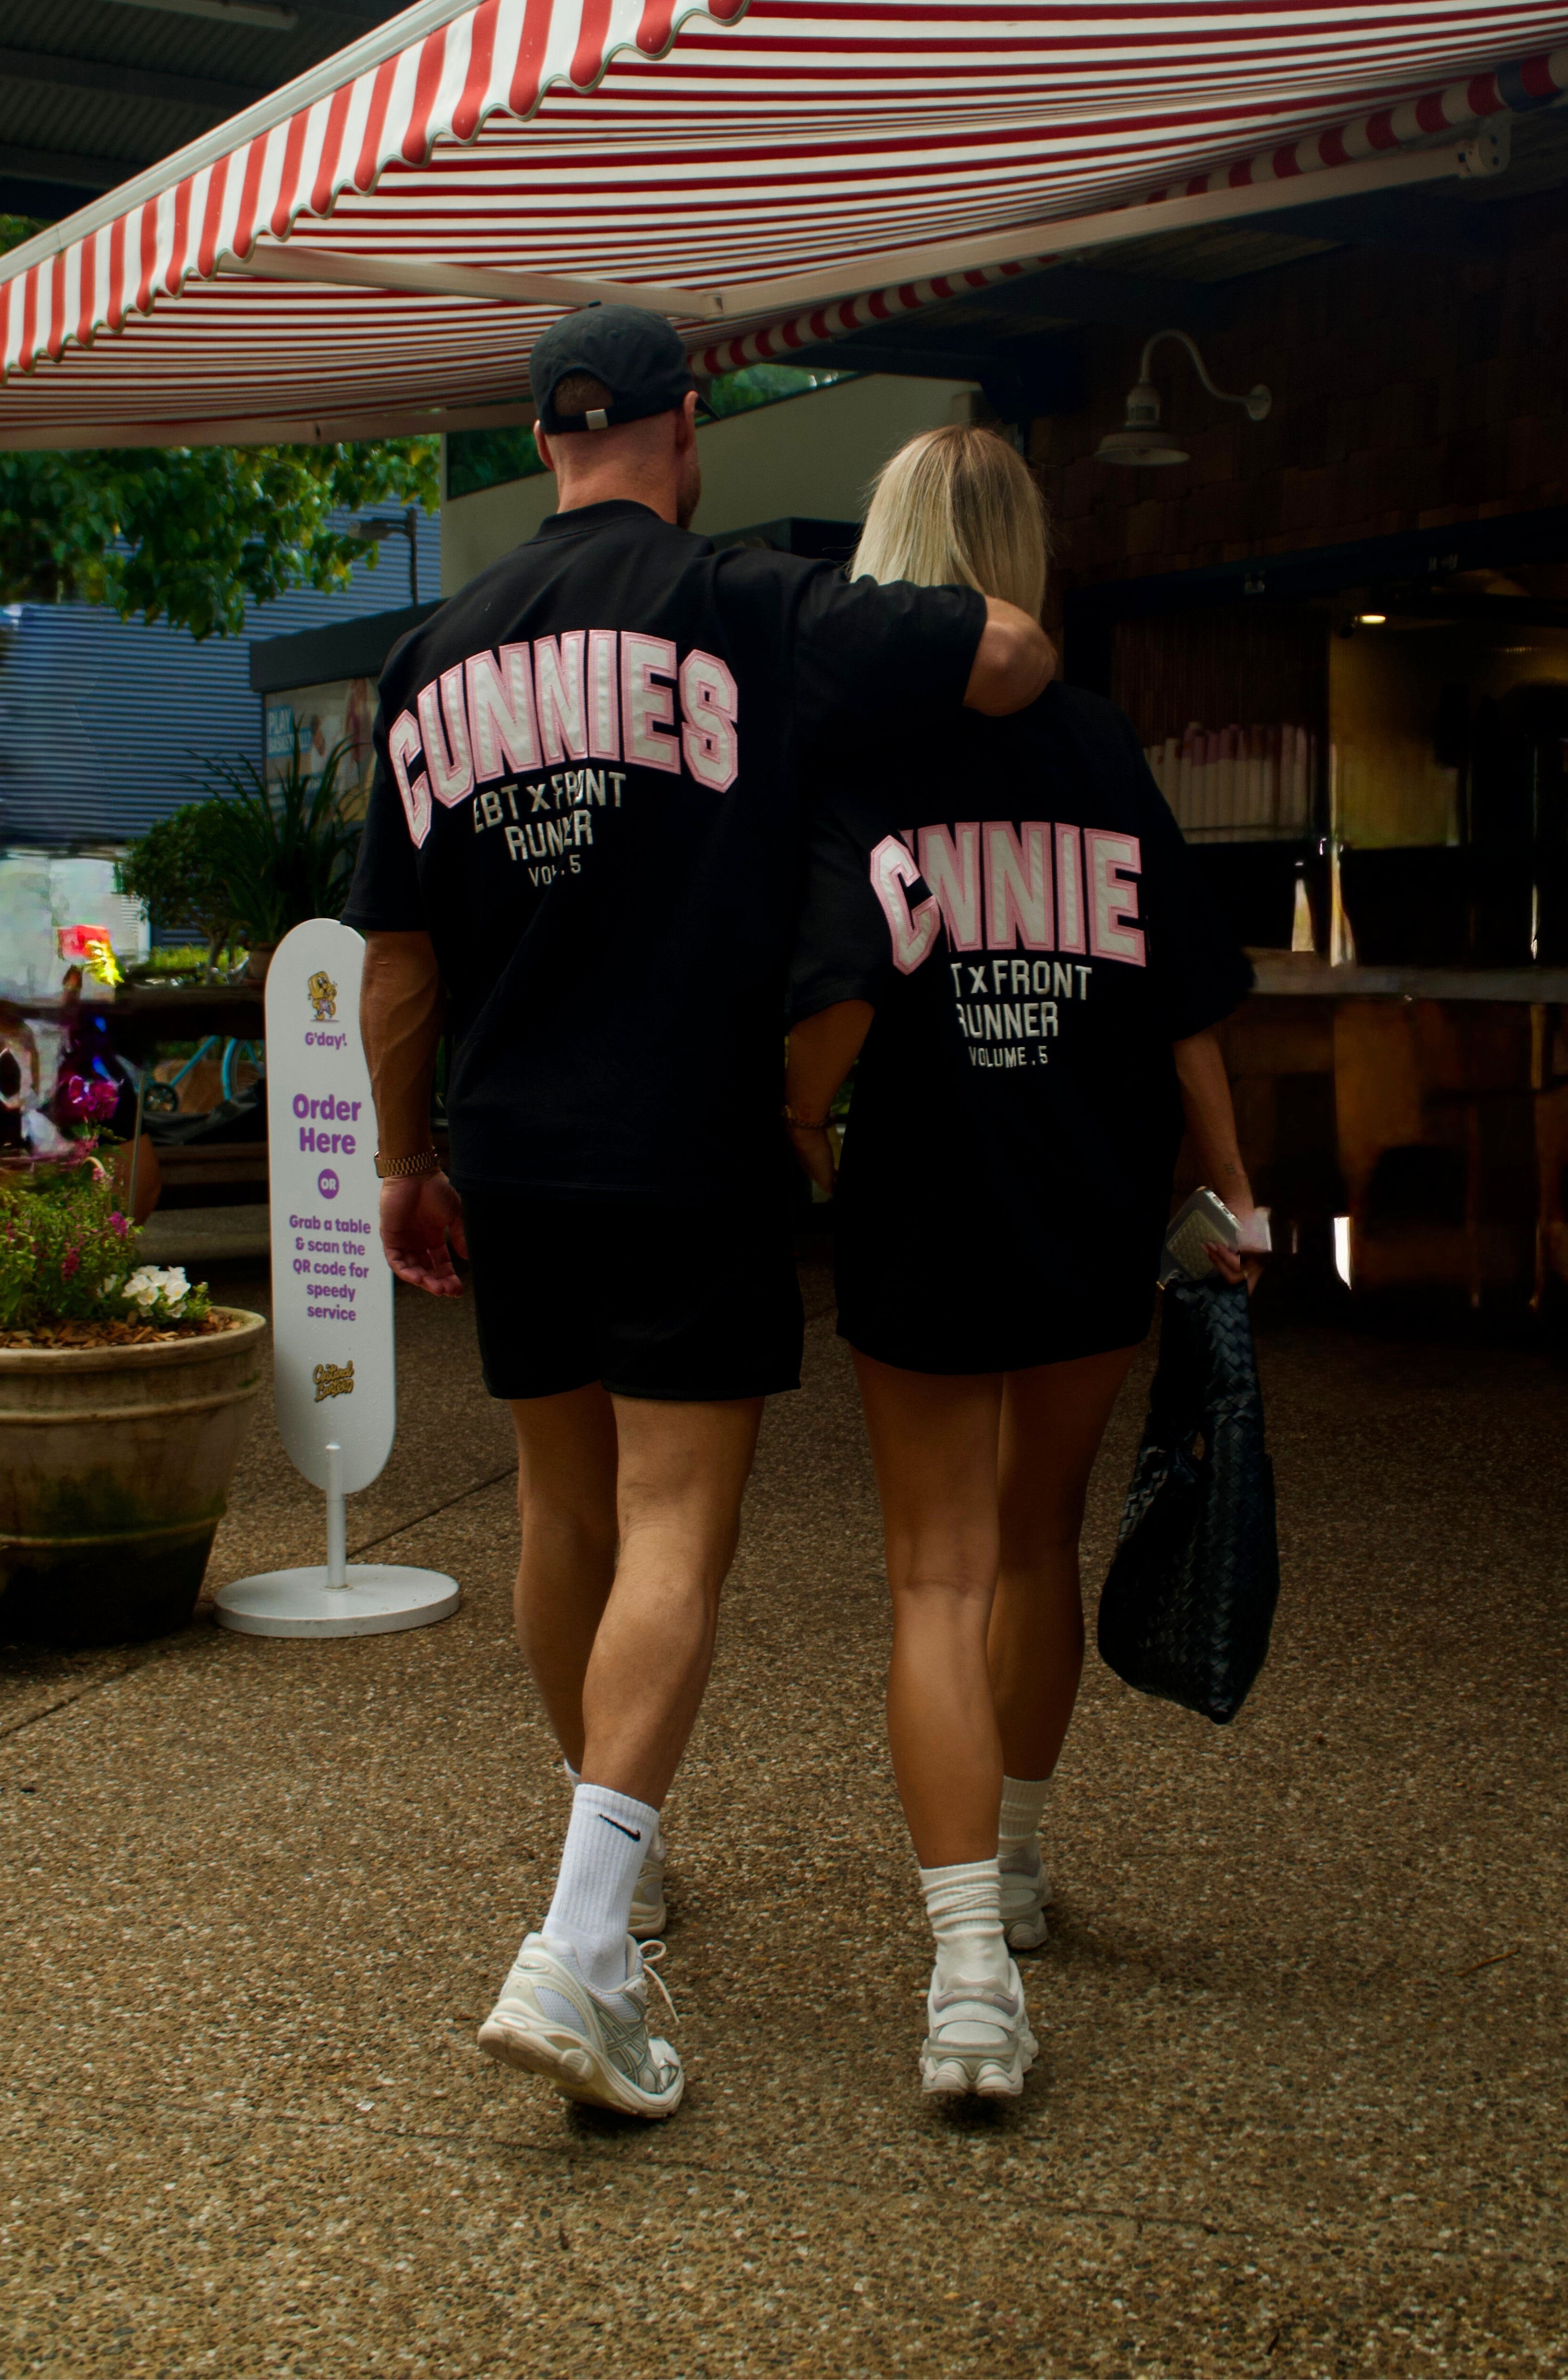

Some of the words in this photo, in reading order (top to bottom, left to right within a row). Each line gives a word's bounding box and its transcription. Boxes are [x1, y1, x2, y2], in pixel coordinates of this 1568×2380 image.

[389, 629, 738, 849] CUNNIES
[871, 821, 1146, 975] CNNIE
[993, 959, 1092, 1000] FRONT
[305, 1031, 347, 1050] G'day!
[292, 1093, 361, 1121] Order
[299, 1127, 356, 1155] Here
[321, 1177, 337, 1191] OR
[290, 1214, 321, 1230] Grab
[324, 1220, 332, 1230] a
[335, 1218, 371, 1234] table
[296, 1237, 305, 1250] &
[308, 1240, 340, 1253] scan
[342, 1240, 366, 1256] the
[293, 1259, 311, 1274] QR
[314, 1261, 346, 1276] code
[349, 1262, 369, 1278] for
[307, 1284, 356, 1302] speedy
[307, 1304, 356, 1321] service
